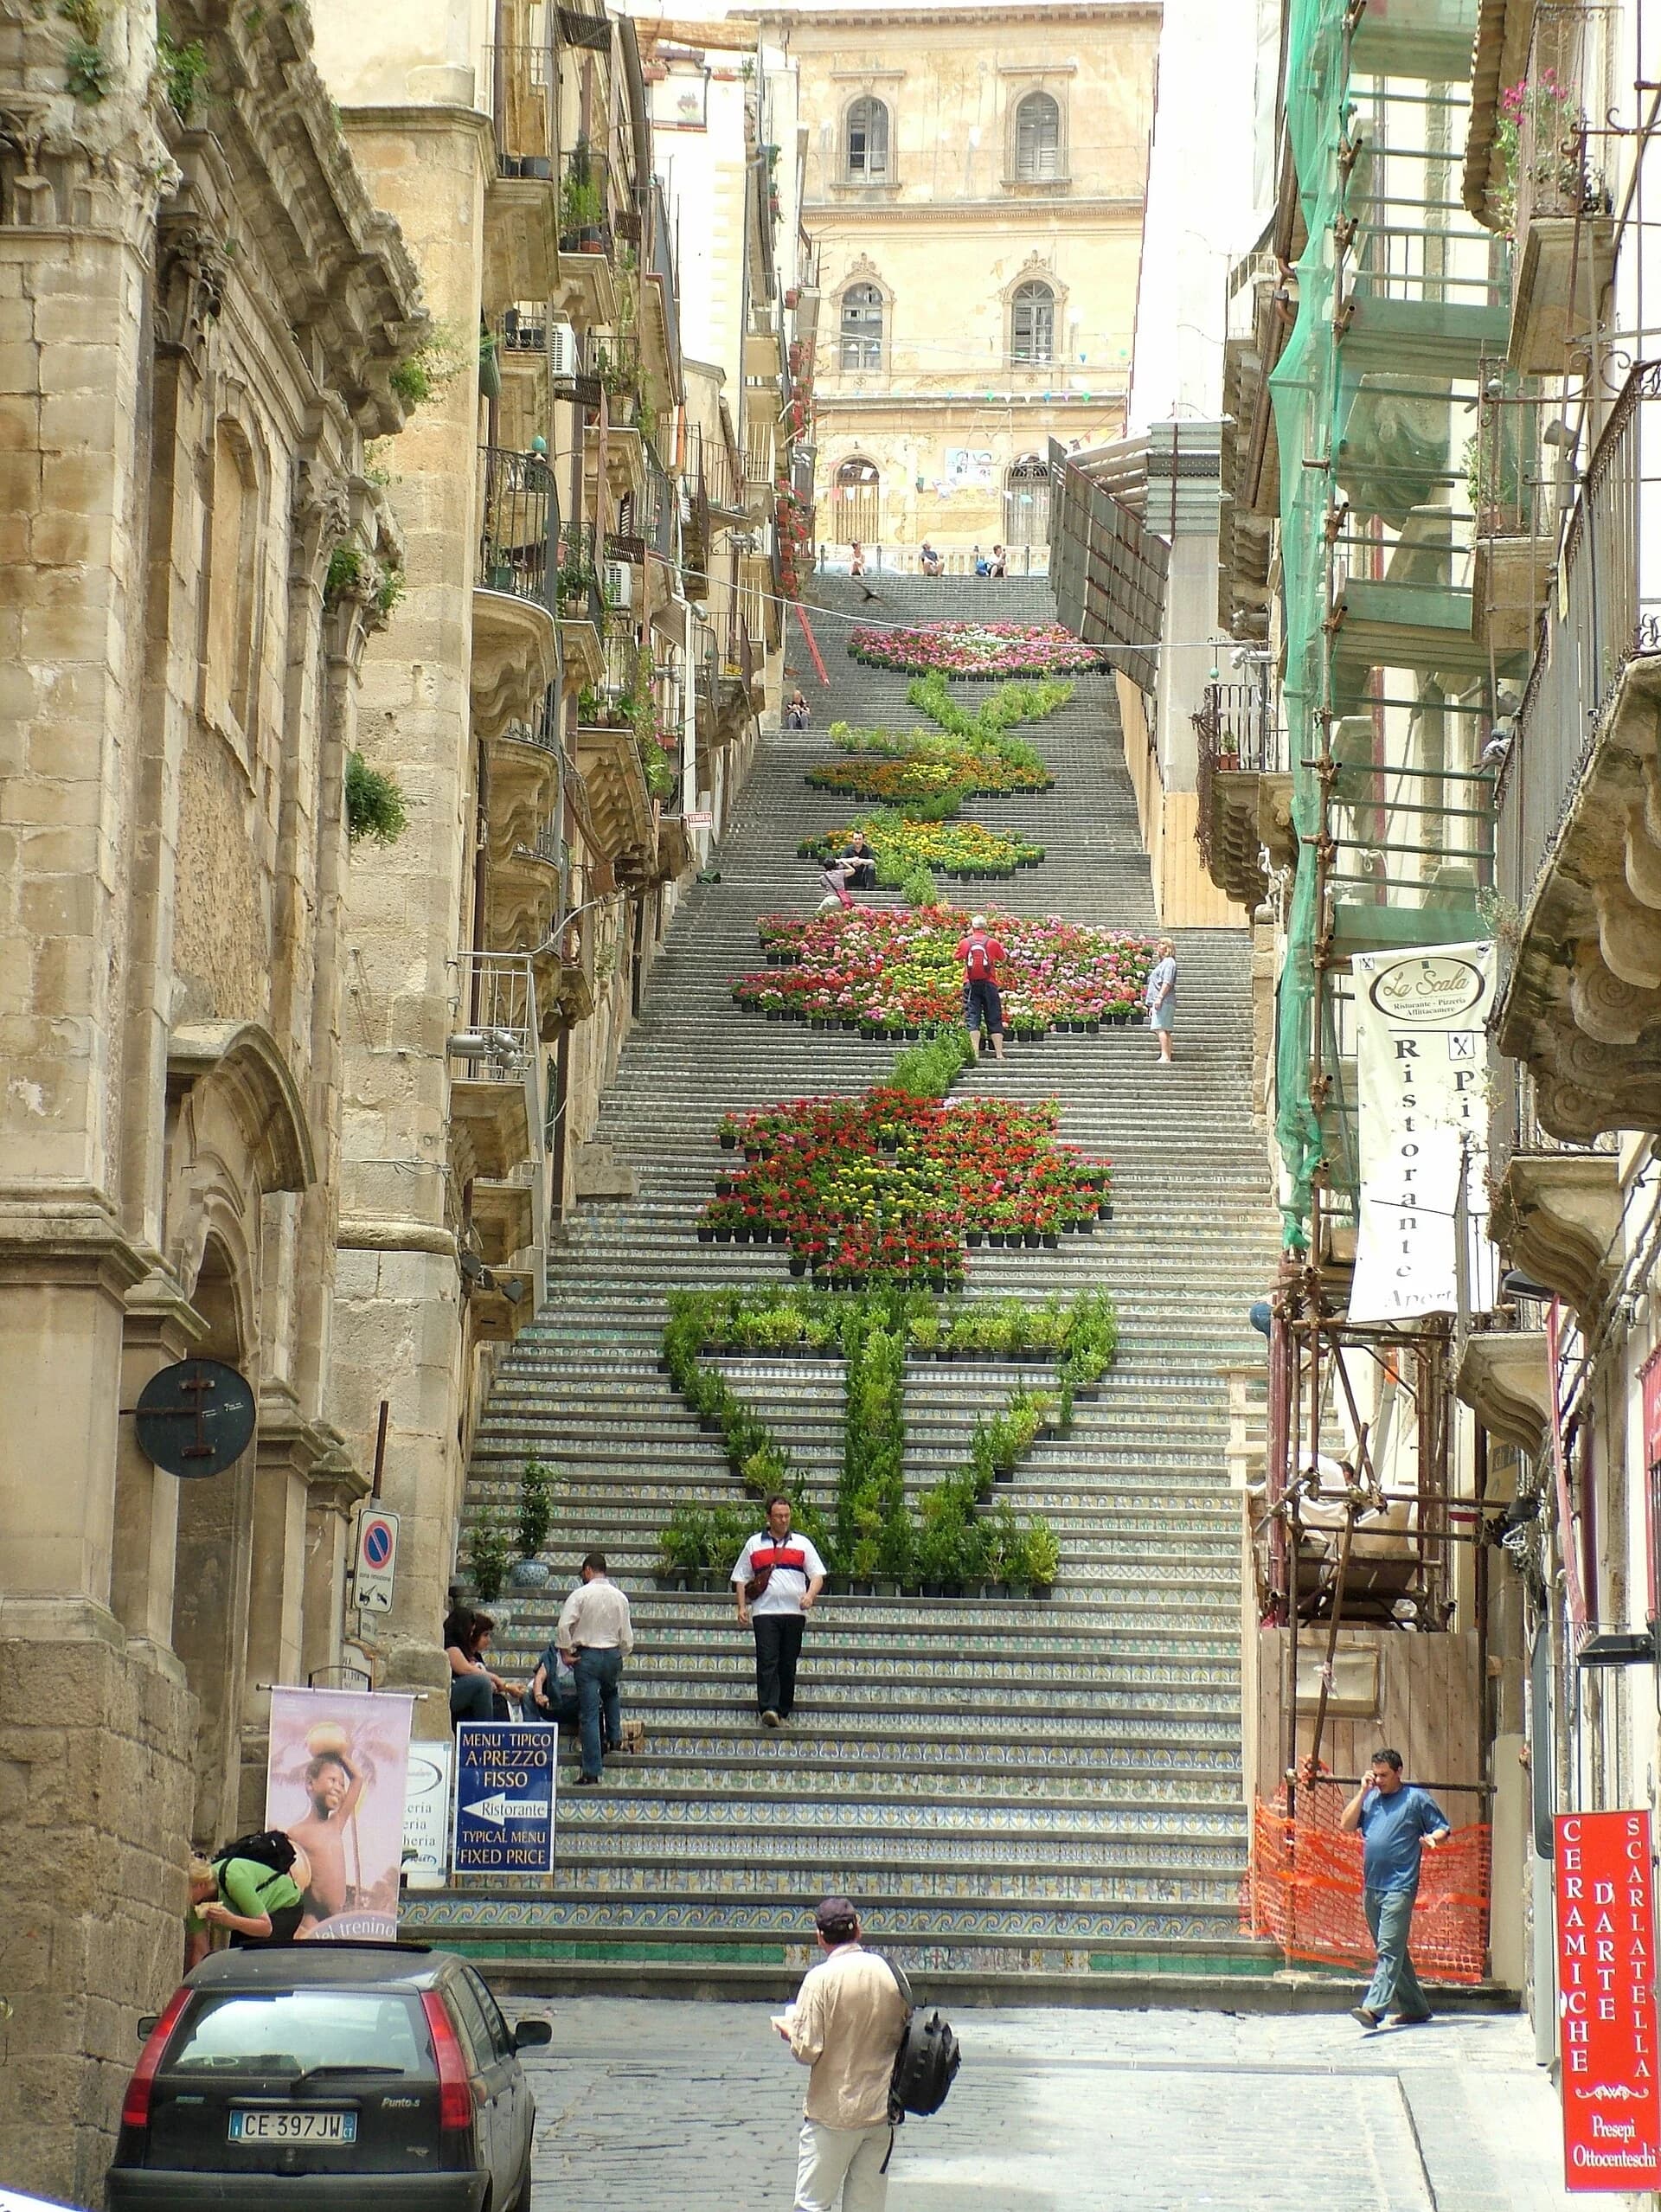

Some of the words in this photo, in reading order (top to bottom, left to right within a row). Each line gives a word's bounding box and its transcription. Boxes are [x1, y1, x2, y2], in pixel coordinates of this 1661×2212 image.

[1383, 971, 1413, 997] La
[1415, 966, 1470, 995] Scala
[1394, 1001, 1432, 1010] Ristorante
[1438, 997, 1466, 1007] Pizzeria
[1393, 1039, 1421, 1278] Ristorante
[463, 1734, 505, 1747] MENU'
[510, 1734, 551, 1747] TIPICO
[465, 1751, 478, 1766] A
[483, 1750, 548, 1766] PREZZO
[484, 1771, 528, 1788] FISSO
[482, 1802, 545, 1817] Ristorante
[462, 1831, 508, 1843] TYPICAL
[511, 1831, 546, 1843] MENU
[461, 1849, 502, 1864] FIXED
[506, 1849, 546, 1864] PRICE
[339, 1917, 394, 1938] trenino
[1563, 1819, 1589, 2072] CERAMICHE
[1626, 1818, 1651, 2078] SCARLATELLA
[381, 2097, 412, 2109] Punto
[245, 2116, 269, 2137] CE
[1592, 2114, 1636, 2144] Presepi
[1573, 2142, 1658, 2168] Ottocenteschi
